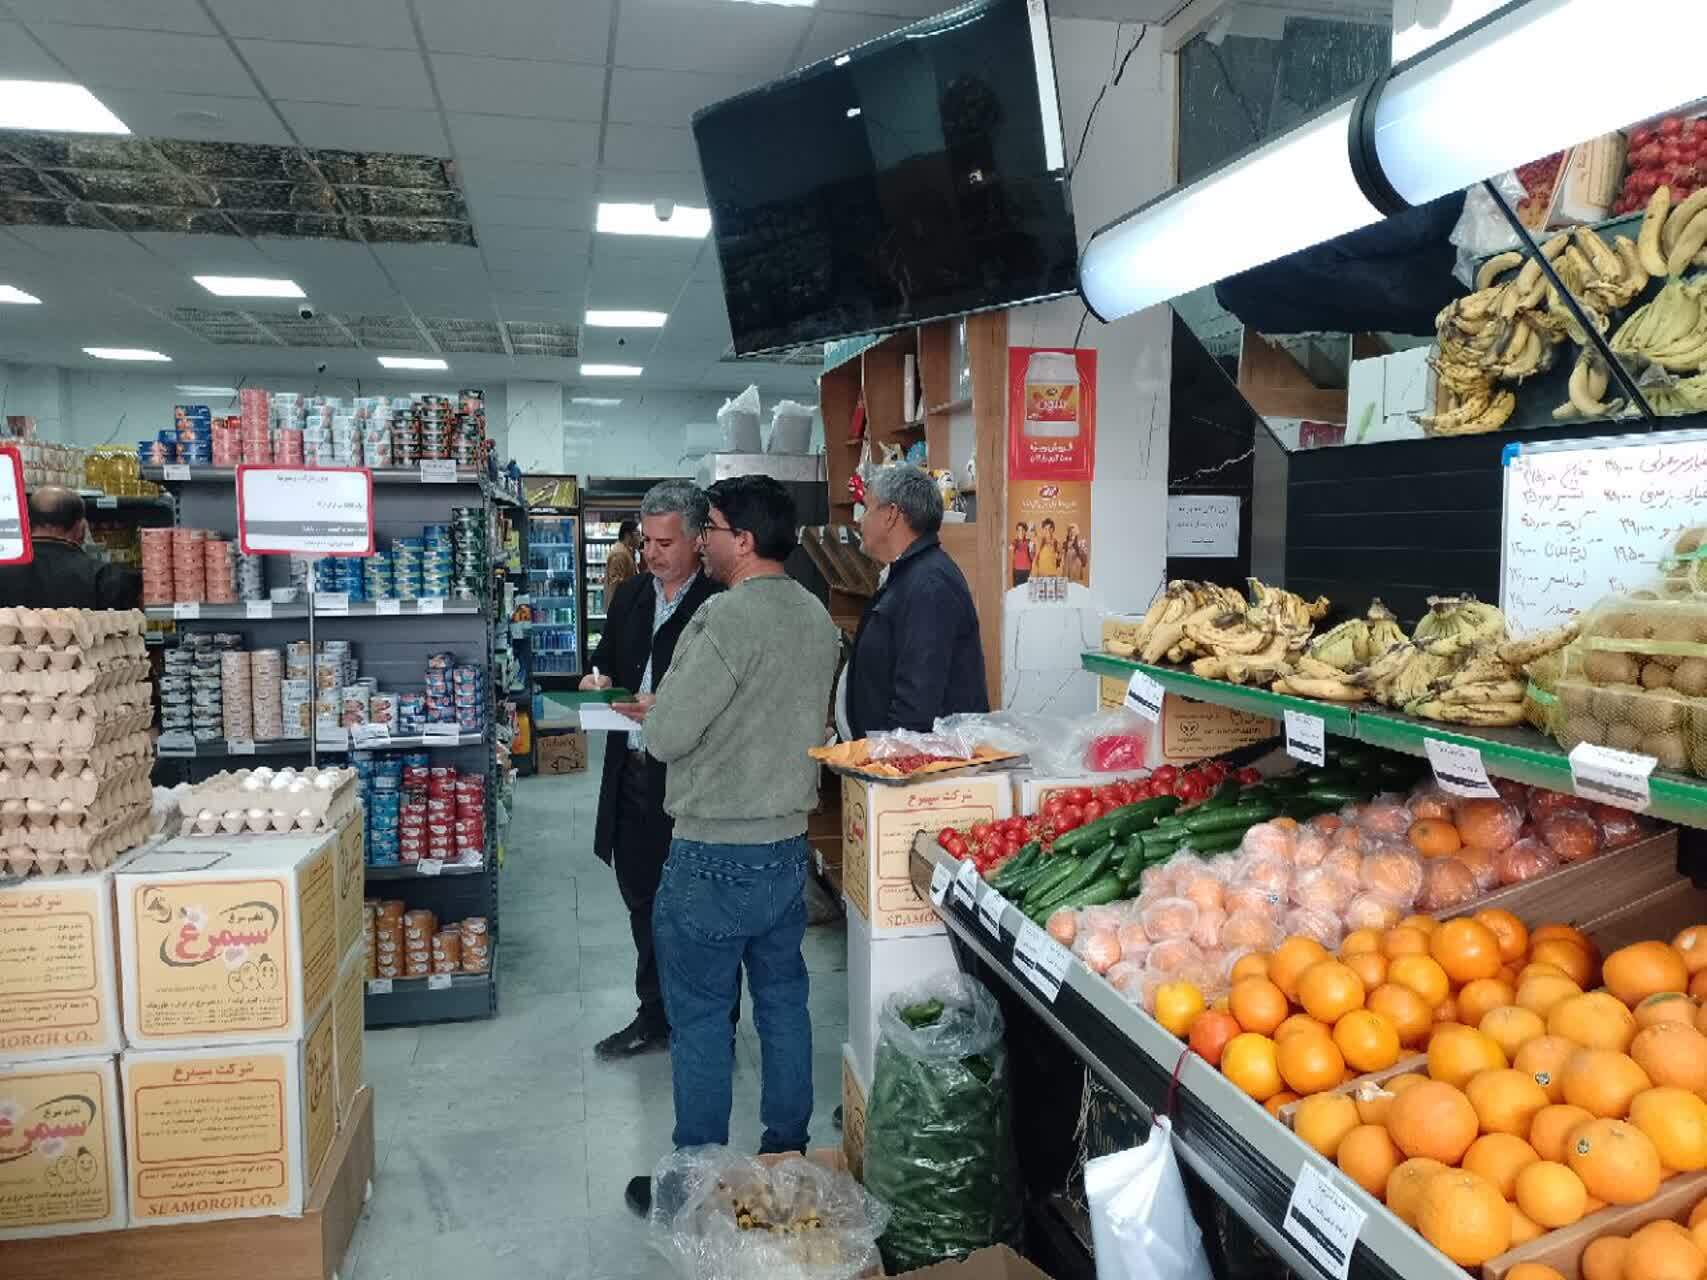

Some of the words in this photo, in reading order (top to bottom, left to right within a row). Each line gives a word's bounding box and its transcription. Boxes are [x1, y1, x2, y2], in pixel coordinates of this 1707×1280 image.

[175, 922, 269, 960] سیمرغ
[216, 1061, 255, 1078] شرکت
[146, 1196, 245, 1217] SEAMORGH
[247, 1193, 278, 1209] CO.
